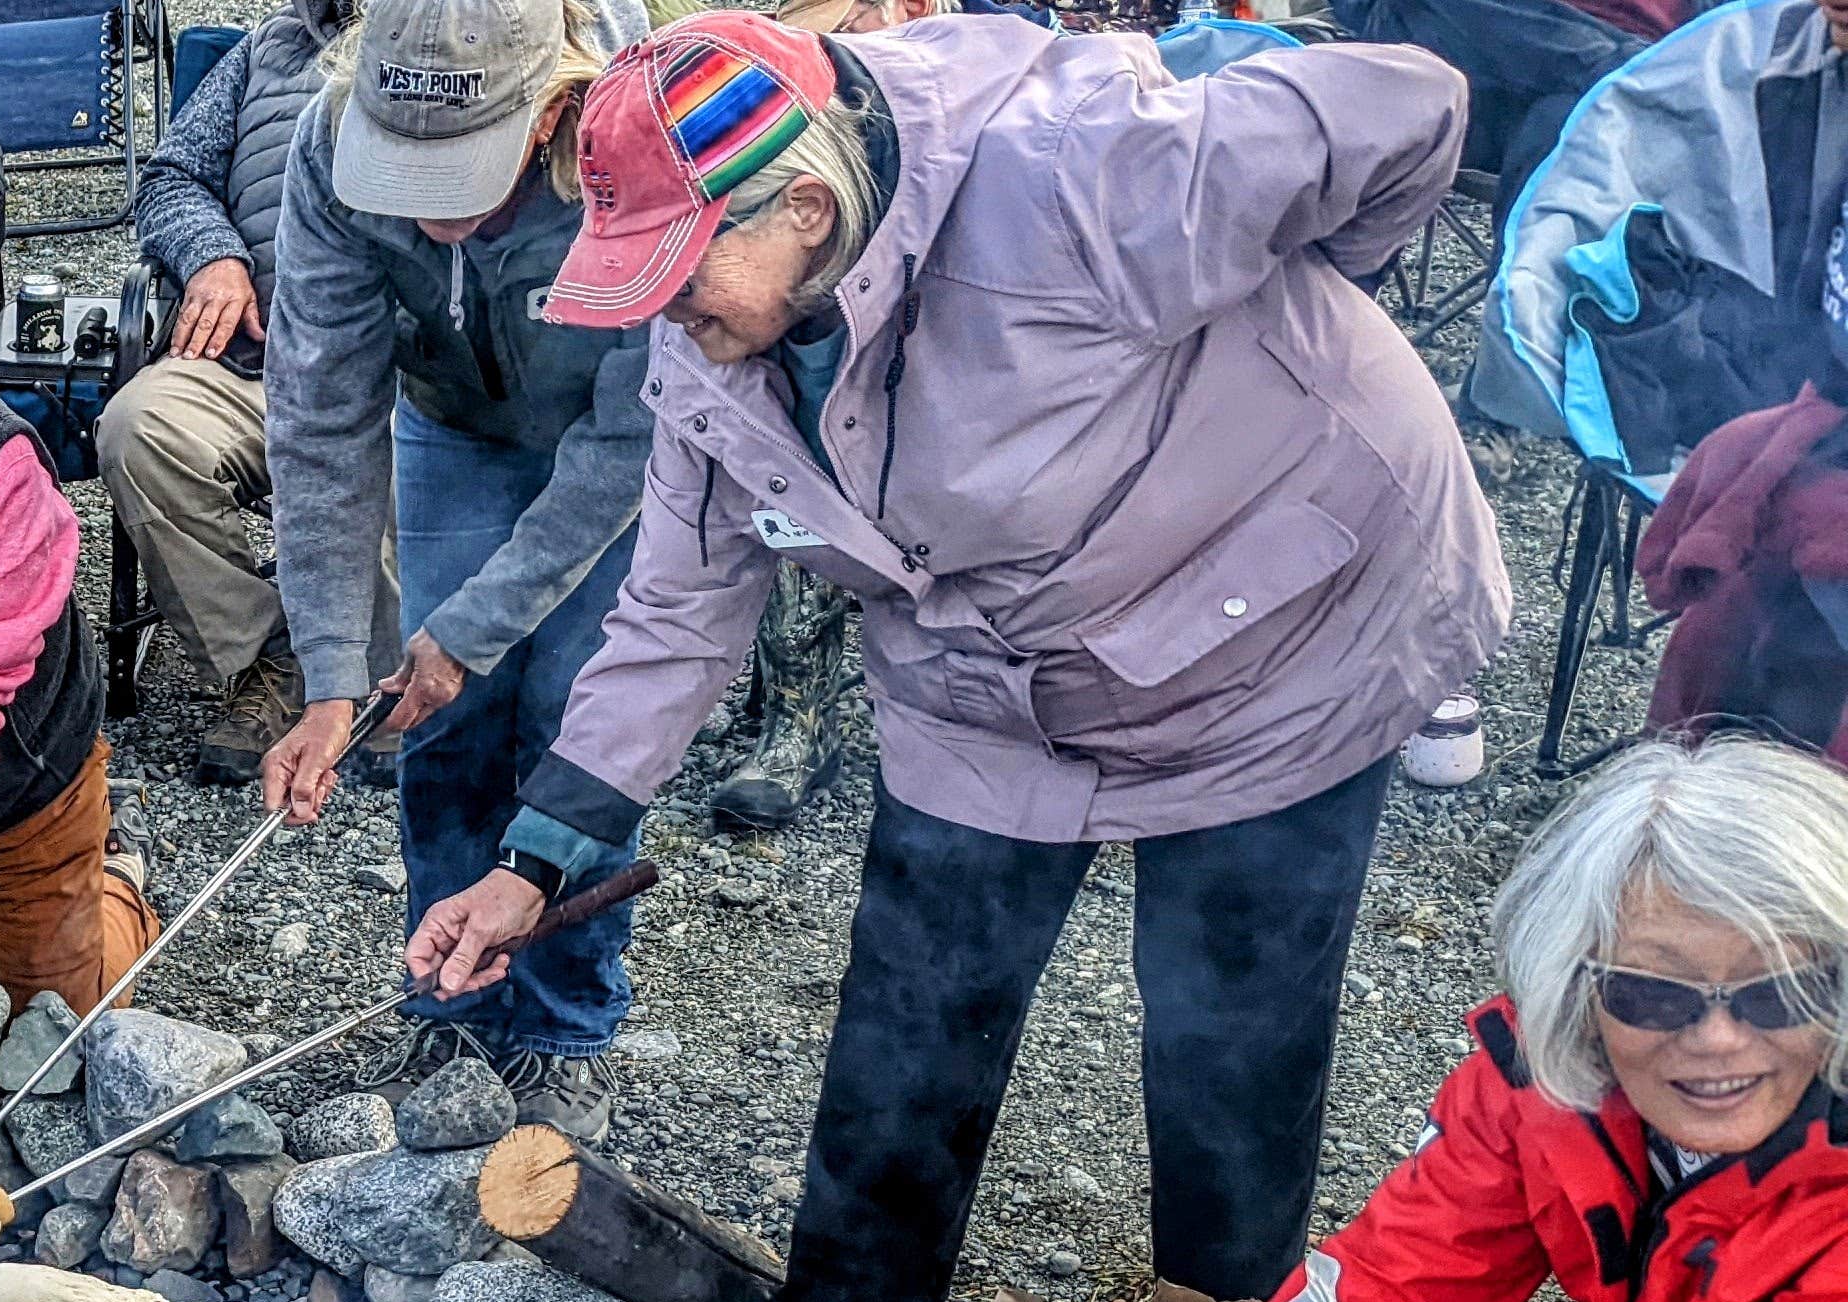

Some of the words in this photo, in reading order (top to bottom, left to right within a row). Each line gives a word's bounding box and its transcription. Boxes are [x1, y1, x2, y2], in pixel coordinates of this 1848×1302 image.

[379, 62, 424, 91] WEST
[389, 93, 401, 101] THE
[403, 93, 423, 102] LONG
[424, 94, 444, 103] GRAY
